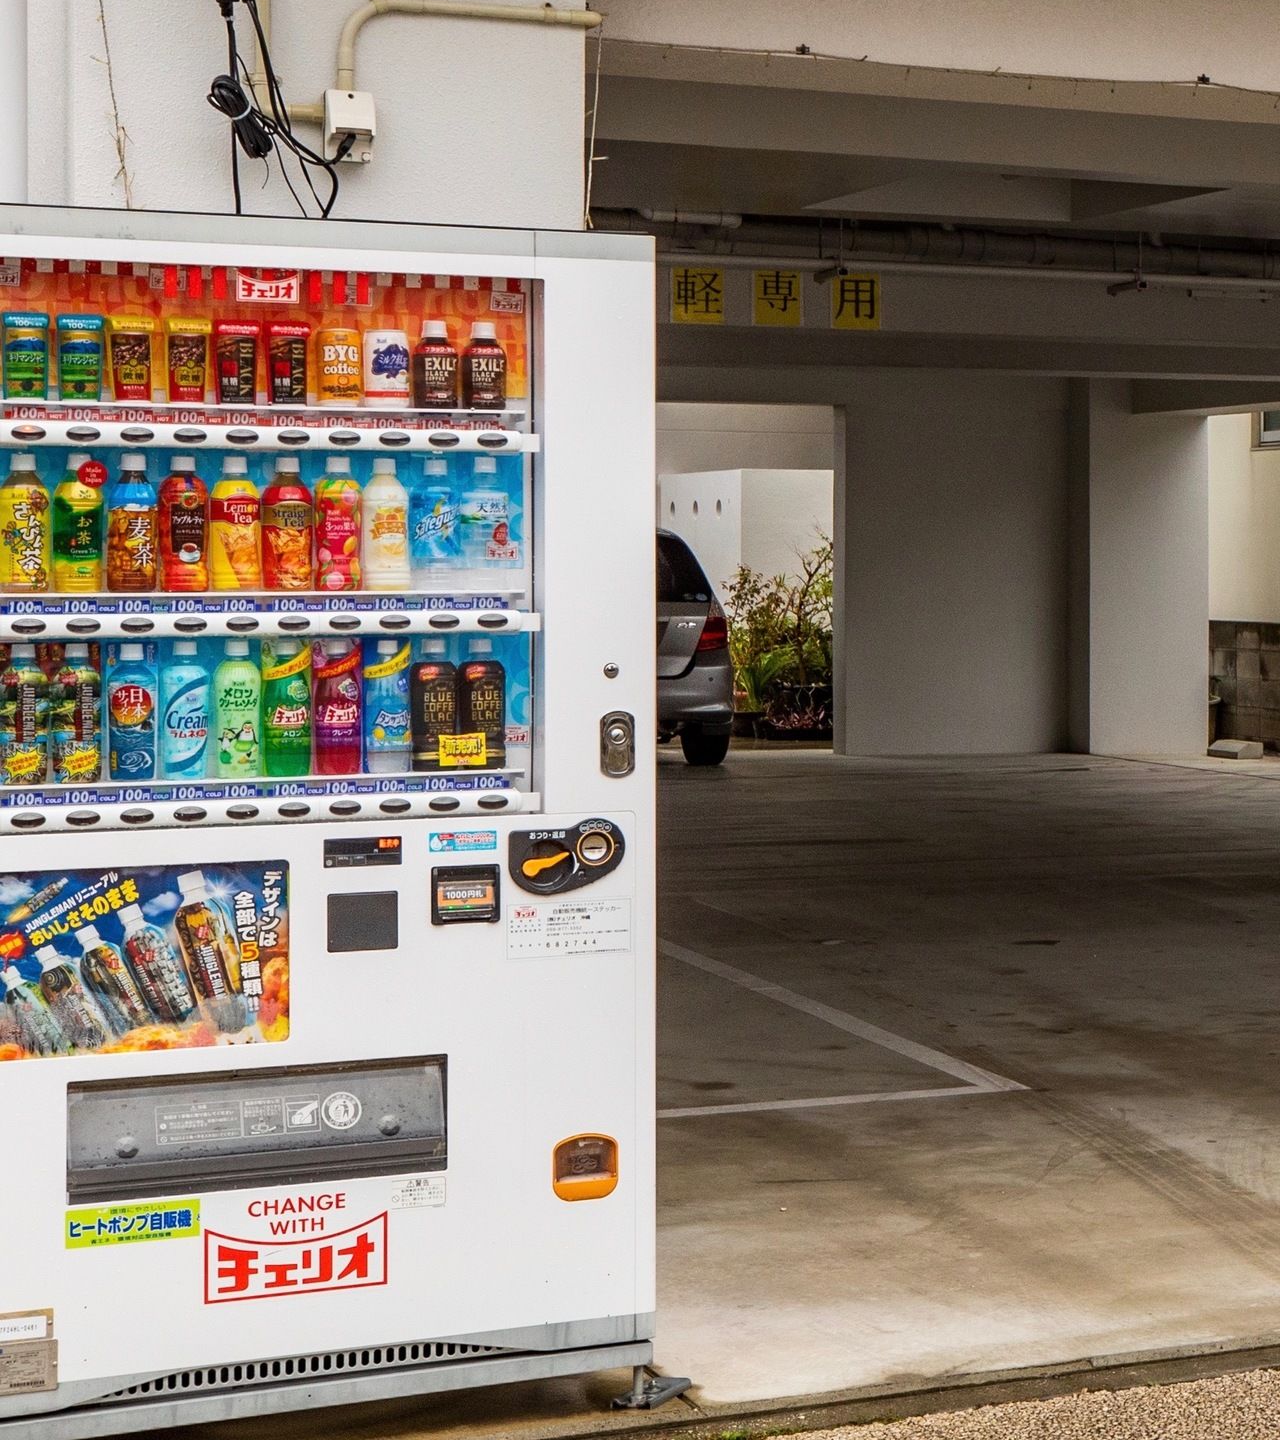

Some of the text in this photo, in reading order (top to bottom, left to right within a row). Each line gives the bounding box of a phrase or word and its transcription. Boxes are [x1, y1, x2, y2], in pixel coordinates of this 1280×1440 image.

[242, 280, 293, 298] チェリオ
[323, 345, 358, 362] BYG
[240, 343, 253, 395] BLACK
[292, 344, 305, 395] BLACK
[324, 365, 359, 375] coffee
[12, 407, 46, 419] 100円
[67, 408, 99, 420] 100円
[121, 410, 152, 421] 100円
[173, 411, 204, 422] 100円
[226, 412, 256, 424] 100円
[273, 415, 302, 427] 100円
[323, 417, 352, 428] 100円
[224, 502, 258, 513] Lemon
[233, 513, 252, 524] Tea
[284, 518, 304, 528] Tea
[14, 502, 43, 570] さんぴん茶
[77, 516, 92, 545] お茶
[129, 517, 153, 568] 麦茶
[8, 601, 42, 613] 100円
[64, 601, 96, 612] 100円
[118, 600, 149, 612] 100円
[171, 600, 202, 612] 100円
[222, 600, 254, 611] 100円
[274, 599, 305, 611] 100円
[324, 599, 354, 610] 100円
[375, 598, 404, 609] 100円
[423, 598, 452, 608] 100円
[472, 598, 501, 608] 100円
[224, 688, 253, 699] メロン
[219, 697, 258, 708] クリームソーダ
[424, 702, 455, 712] COFFE
[471, 700, 502, 710] COFFE
[424, 712, 453, 722] BLAC
[471, 710, 500, 720] BLAC
[325, 782, 355, 794] 100円
[375, 781, 405, 792] 100円
[424, 779, 453, 790] 100円
[473, 777, 501, 788] 100円
[118, 789, 150, 802] 100円
[172, 788, 203, 800] 100円
[224, 786, 255, 797] 100円
[275, 784, 306, 796] 100円
[9, 793, 42, 806] 100円
[64, 791, 96, 803] 100円
[446, 890, 483, 899] 1000円札
[24, 871, 118, 934] JUNGLEMAN リニューアル
[258, 870, 282, 947] デザインは
[28, 878, 140, 946] おいしさそのまま
[248, 1193, 346, 1219] CHANGE
[70, 1210, 191, 1237] ヒートポンプ自販機
[270, 1217, 324, 1236] WITH
[217, 1232, 374, 1294] チェリオ
